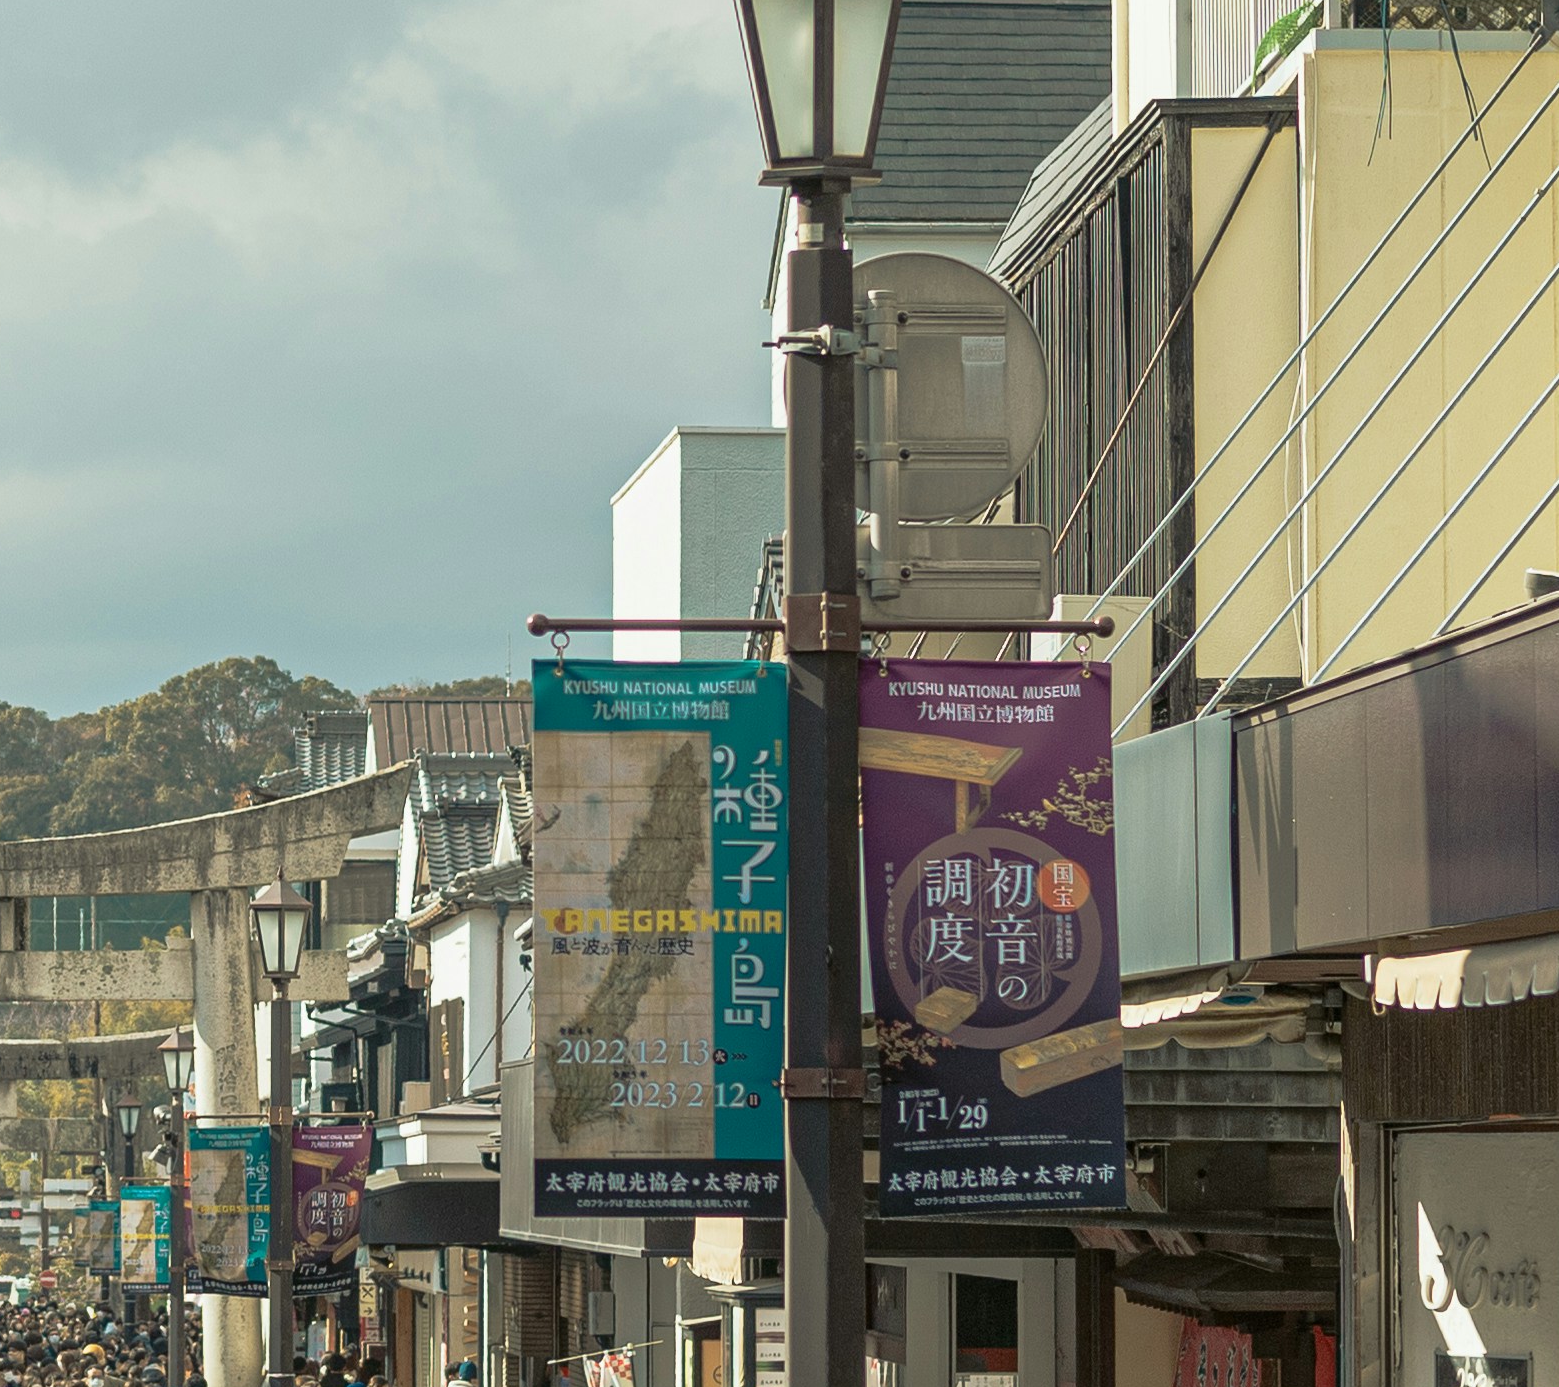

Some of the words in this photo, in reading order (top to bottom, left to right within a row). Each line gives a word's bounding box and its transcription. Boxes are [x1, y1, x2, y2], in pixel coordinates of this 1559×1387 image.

[563, 680, 618, 694] KYUSHU
[623, 681, 693, 695] NATIONAL
[698, 680, 757, 694] MUSEUM
[888, 681, 944, 697] KYUSHU
[948, 684, 1018, 700] NATIONAL
[1022, 683, 1082, 700] MUSEUM
[592, 700, 730, 721] 九州国立博物館
[917, 701, 1055, 724] 九州国立博物館
[1052, 862, 1075, 908] 国宝
[540, 907, 783, 934] TANEGASHIMA
[923, 858, 975, 964] 調度
[985, 858, 1038, 1001] 初音の
[550, 936, 695, 957] 風と波が育んだ歴史
[545, 1170, 780, 1194] 太宰府観光協会・太宰府市
[887, 1163, 1118, 1193] 太宰府観光協会・太宰府市
[310, 1191, 327, 1226] 調度
[330, 1191, 346, 1238] 初音の
